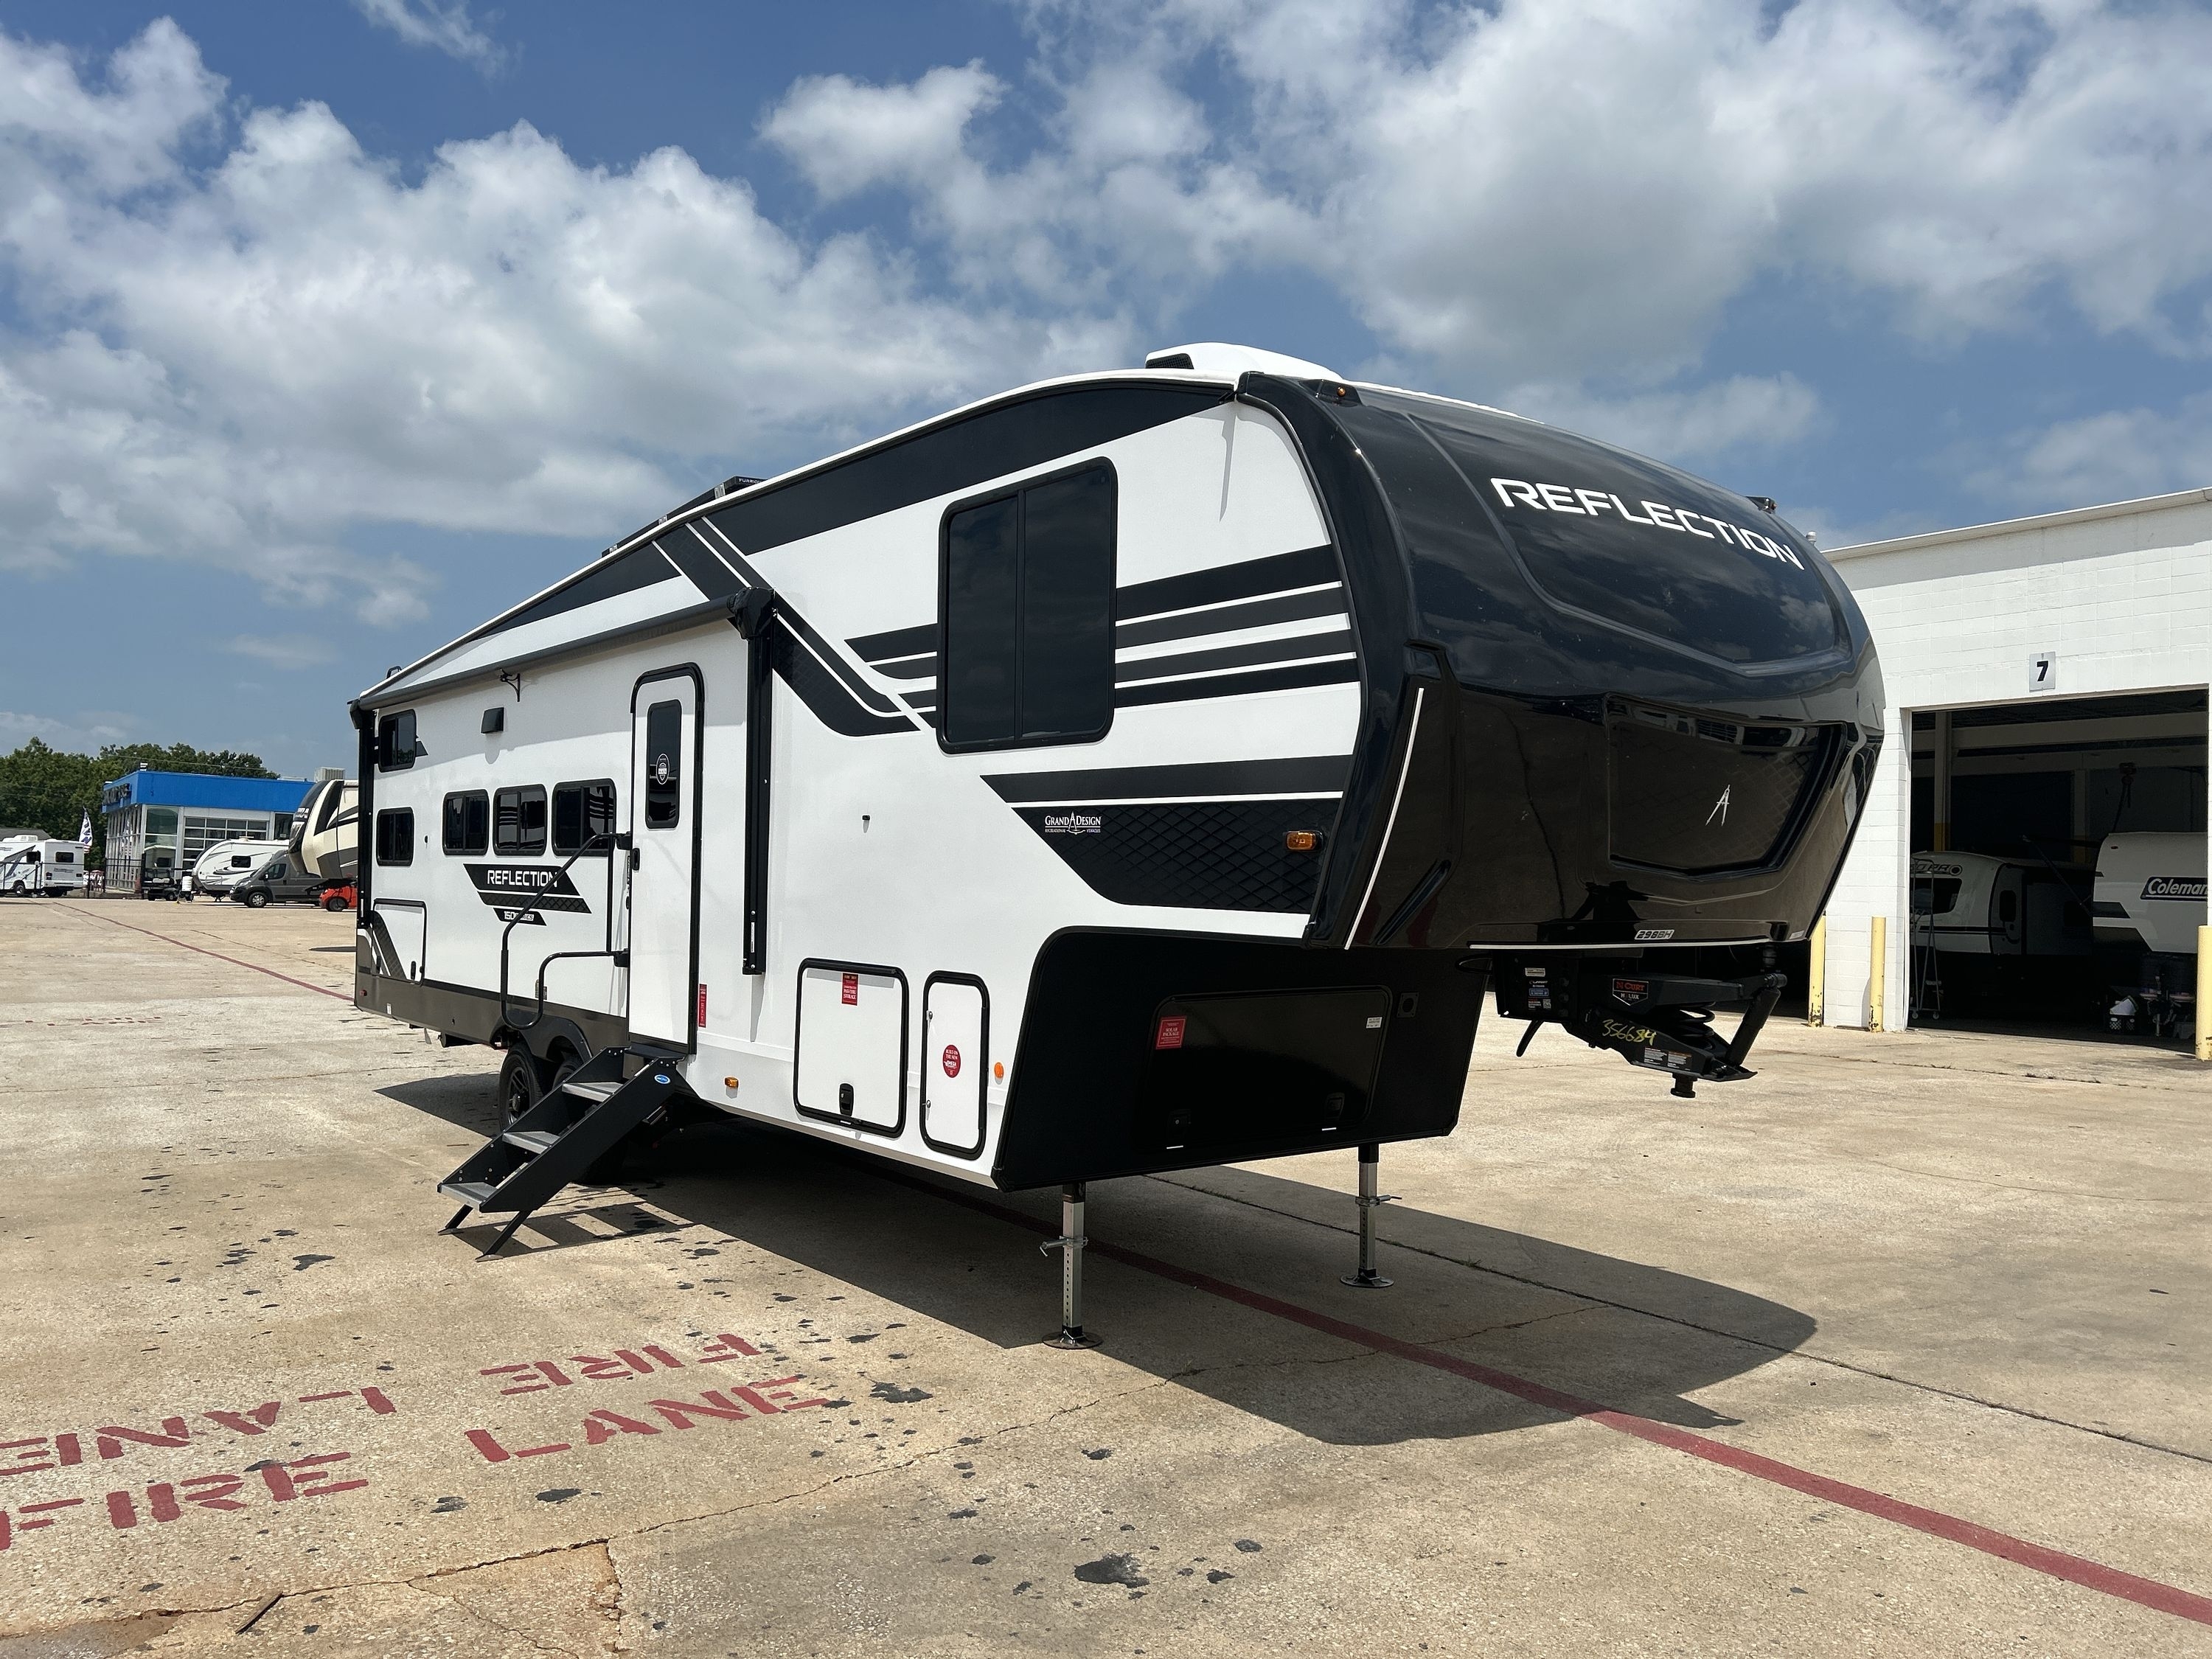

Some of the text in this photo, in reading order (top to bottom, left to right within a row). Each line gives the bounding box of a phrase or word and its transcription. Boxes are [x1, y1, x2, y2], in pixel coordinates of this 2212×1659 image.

[1490, 477, 1805, 571] REFLECTION
[2037, 660, 2049, 682] 7
[1045, 815, 1102, 826] GRAND DESIGN
[487, 870, 557, 887] REFLECTION
[2148, 878, 2208, 895] Coleman
[1635, 930, 1674, 940] 298BH
[1602, 1019, 1657, 1046] 356684
[480, 1333, 762, 1395] FIRE
[0, 1376, 831, 1550] FIRE LANE
